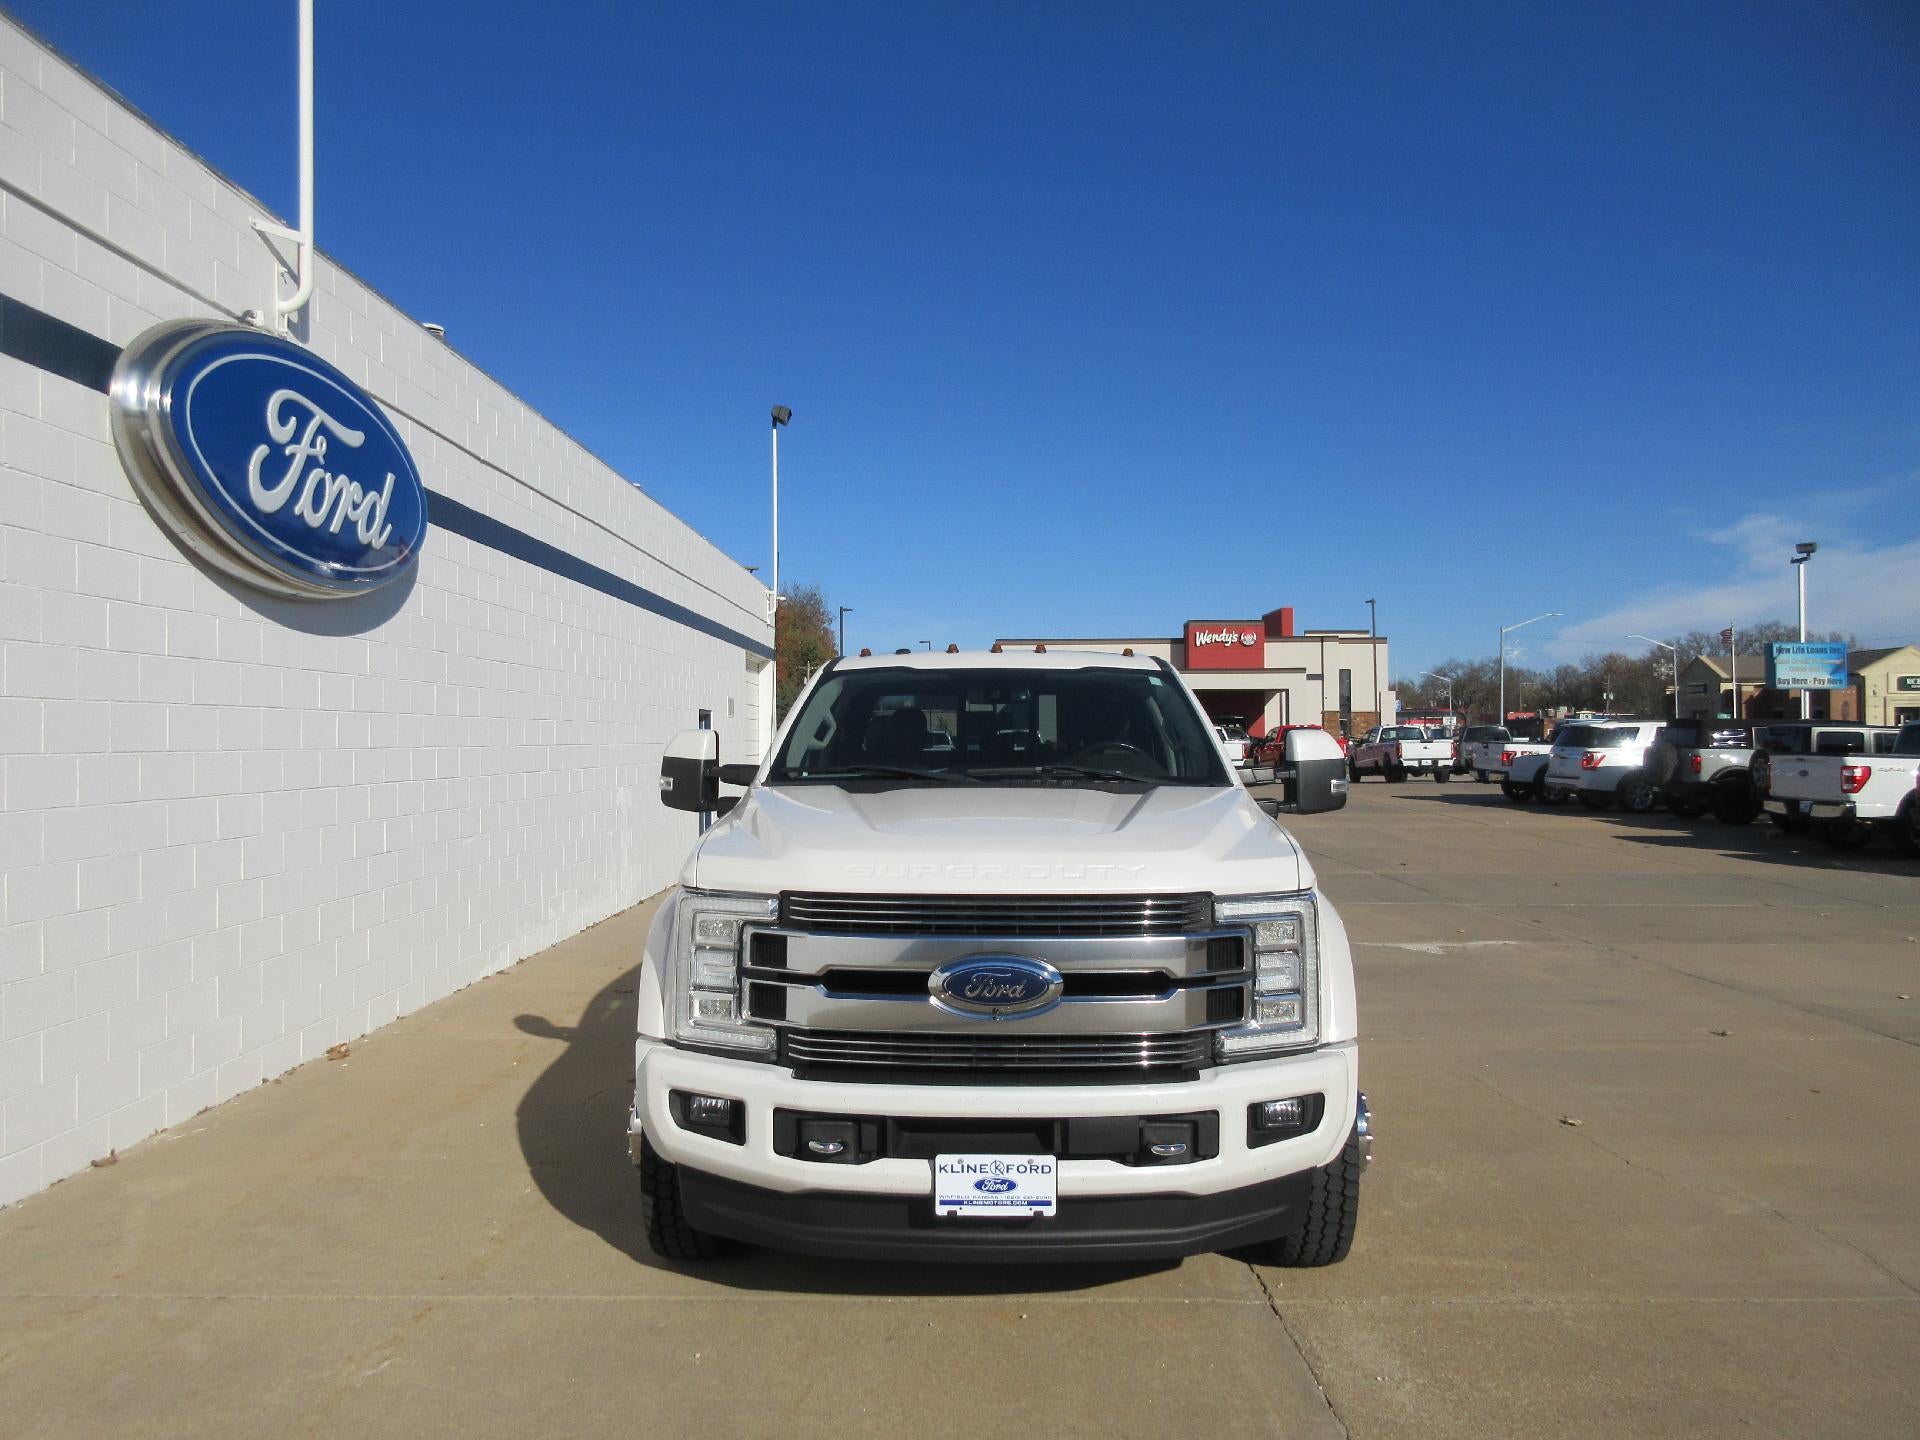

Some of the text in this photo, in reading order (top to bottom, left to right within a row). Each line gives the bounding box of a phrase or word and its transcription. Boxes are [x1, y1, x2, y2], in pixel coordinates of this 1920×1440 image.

[250, 389, 395, 550] Ford
[1195, 628, 1238, 647] Wendy's
[1812, 677, 1825, 686] Pay
[845, 863, 1146, 879] SUPER DUTY
[964, 973, 1028, 998] Ford
[939, 1164, 988, 1174] KLINE
[1007, 1164, 1052, 1174] FORD
[981, 1178, 1009, 1191] Ford
